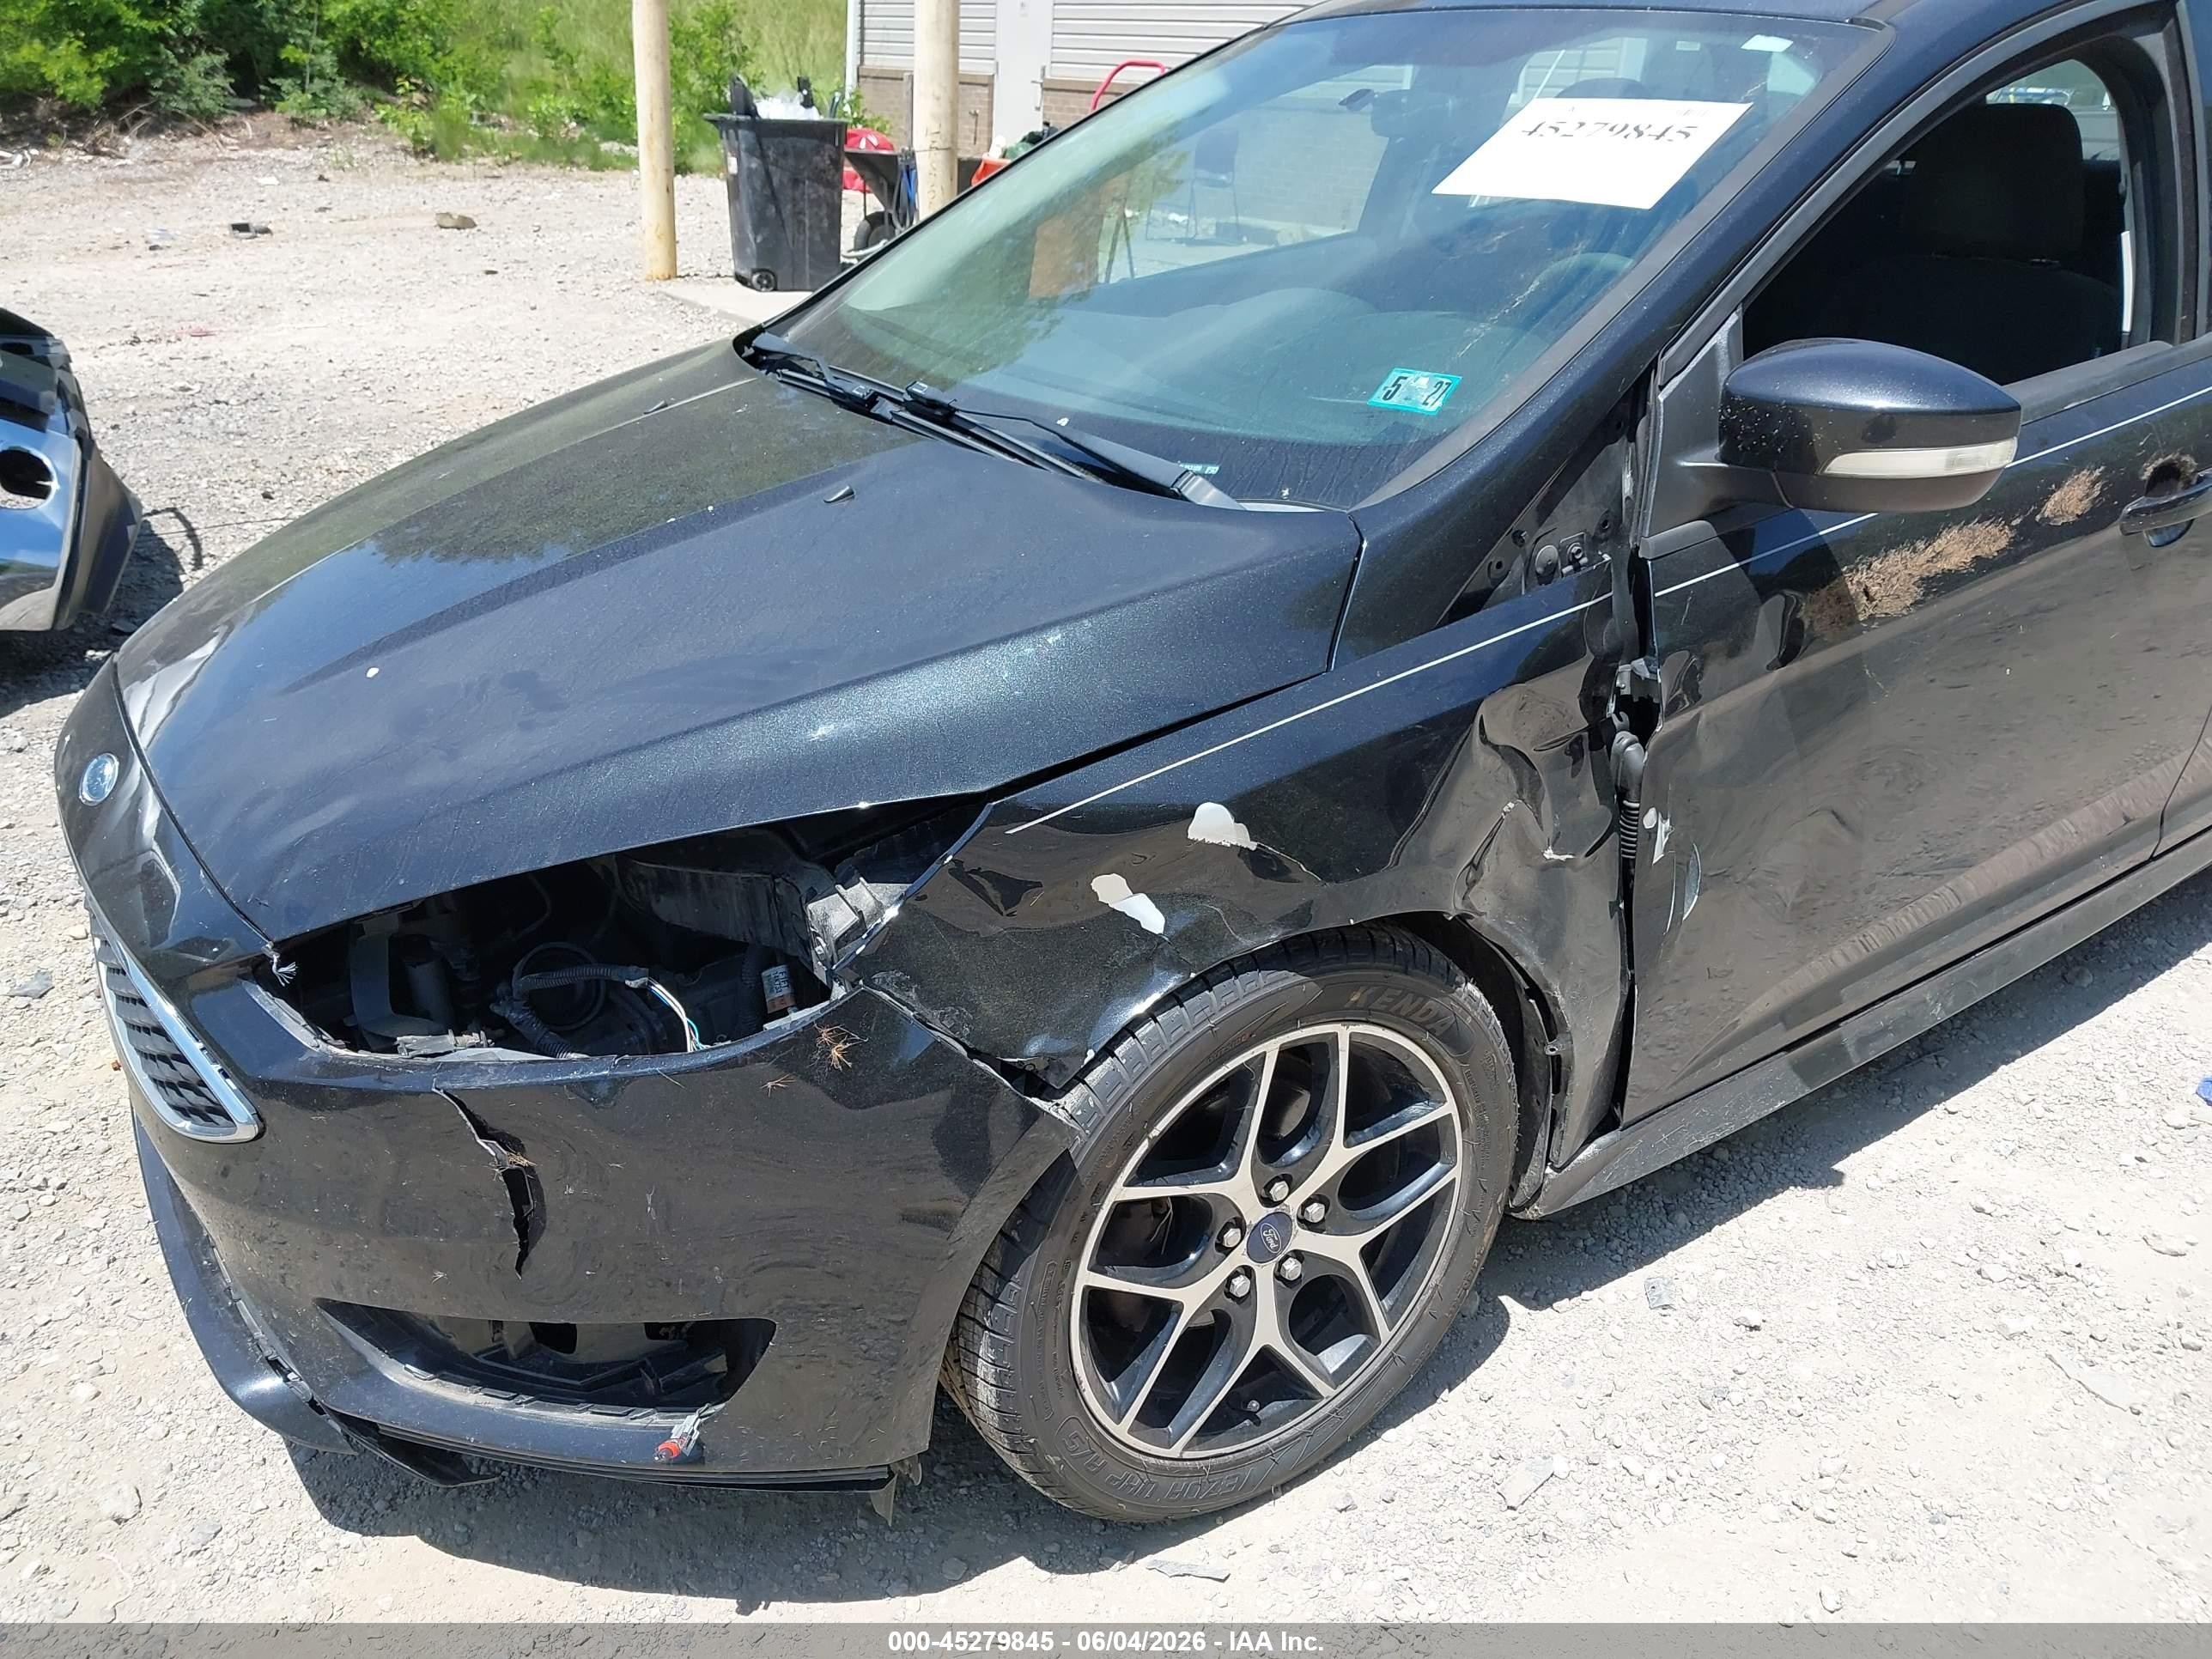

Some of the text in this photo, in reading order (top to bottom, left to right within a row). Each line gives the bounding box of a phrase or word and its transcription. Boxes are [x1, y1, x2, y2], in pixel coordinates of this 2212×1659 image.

[1520, 119, 1698, 143] 45279845
[1421, 380, 1452, 407] 27
[1344, 985, 1457, 1036] KENDA
